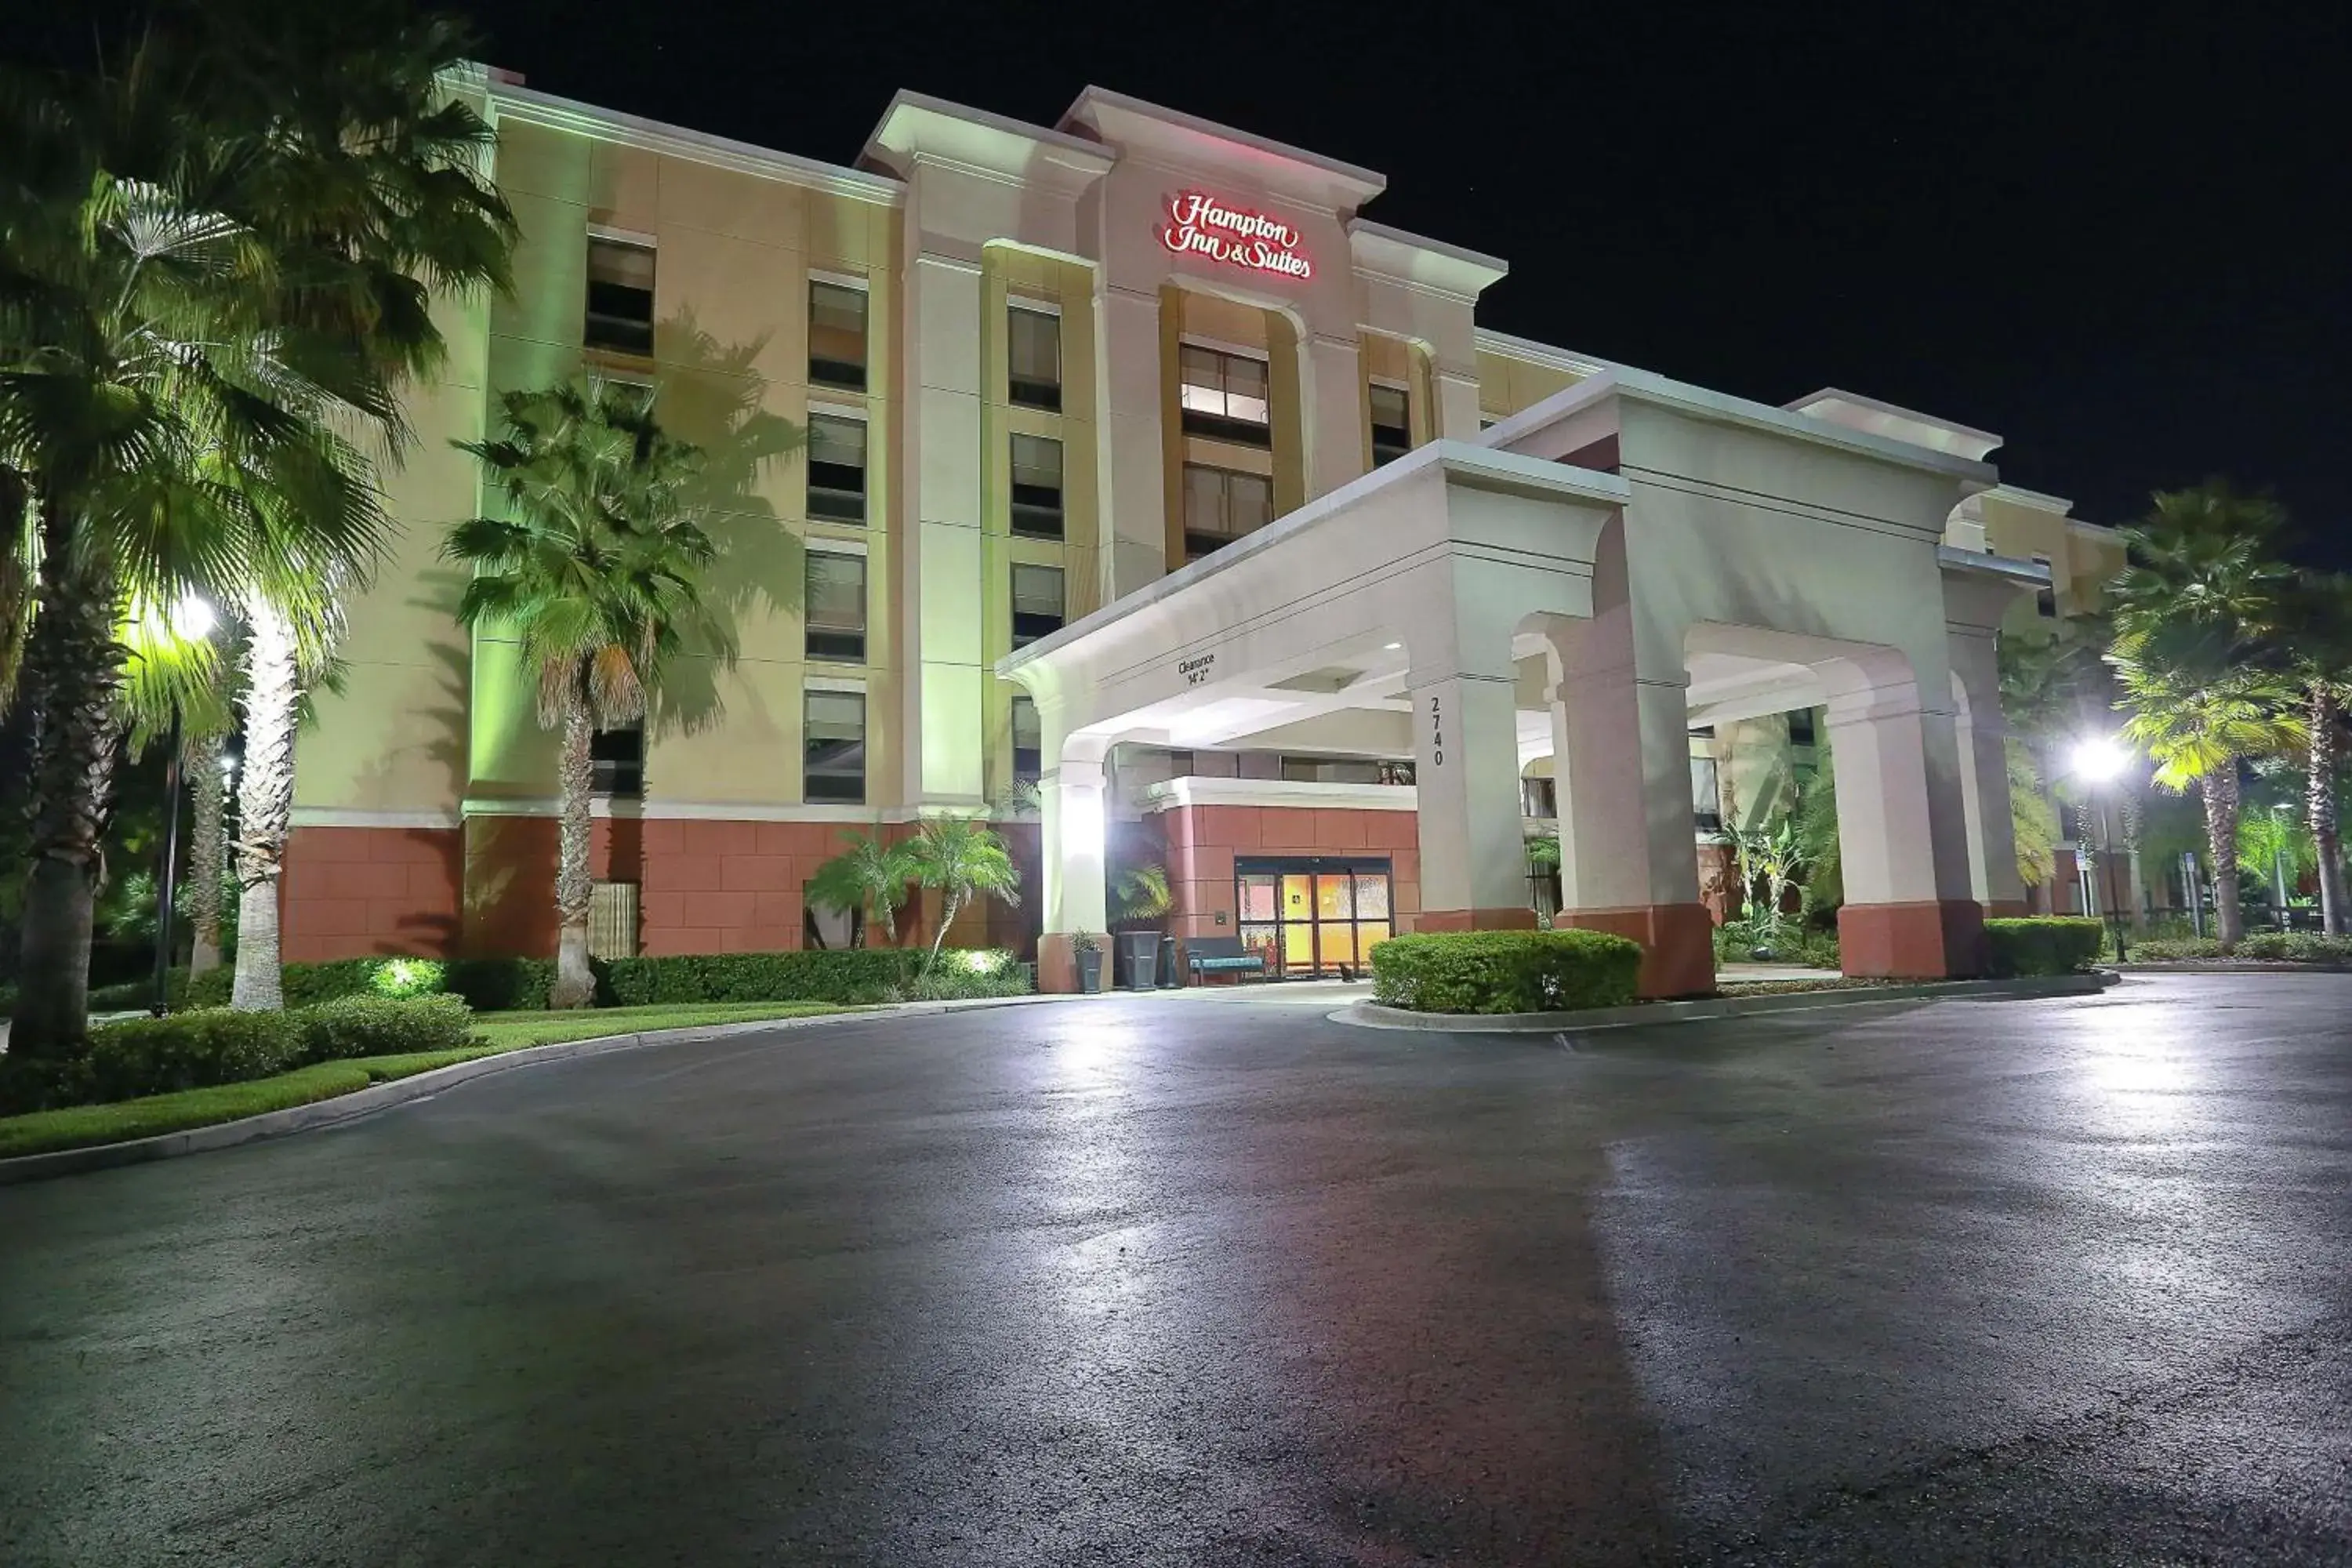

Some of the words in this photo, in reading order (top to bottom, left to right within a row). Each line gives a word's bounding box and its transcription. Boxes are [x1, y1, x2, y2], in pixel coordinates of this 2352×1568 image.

[1172, 195, 1298, 248] Hampton
[1164, 227, 1230, 260] Inn
[1230, 244, 1248, 266] &
[1245, 241, 1311, 278] Suites
[1179, 654, 1214, 674] Clearance
[1431, 697, 1443, 766] 2740
